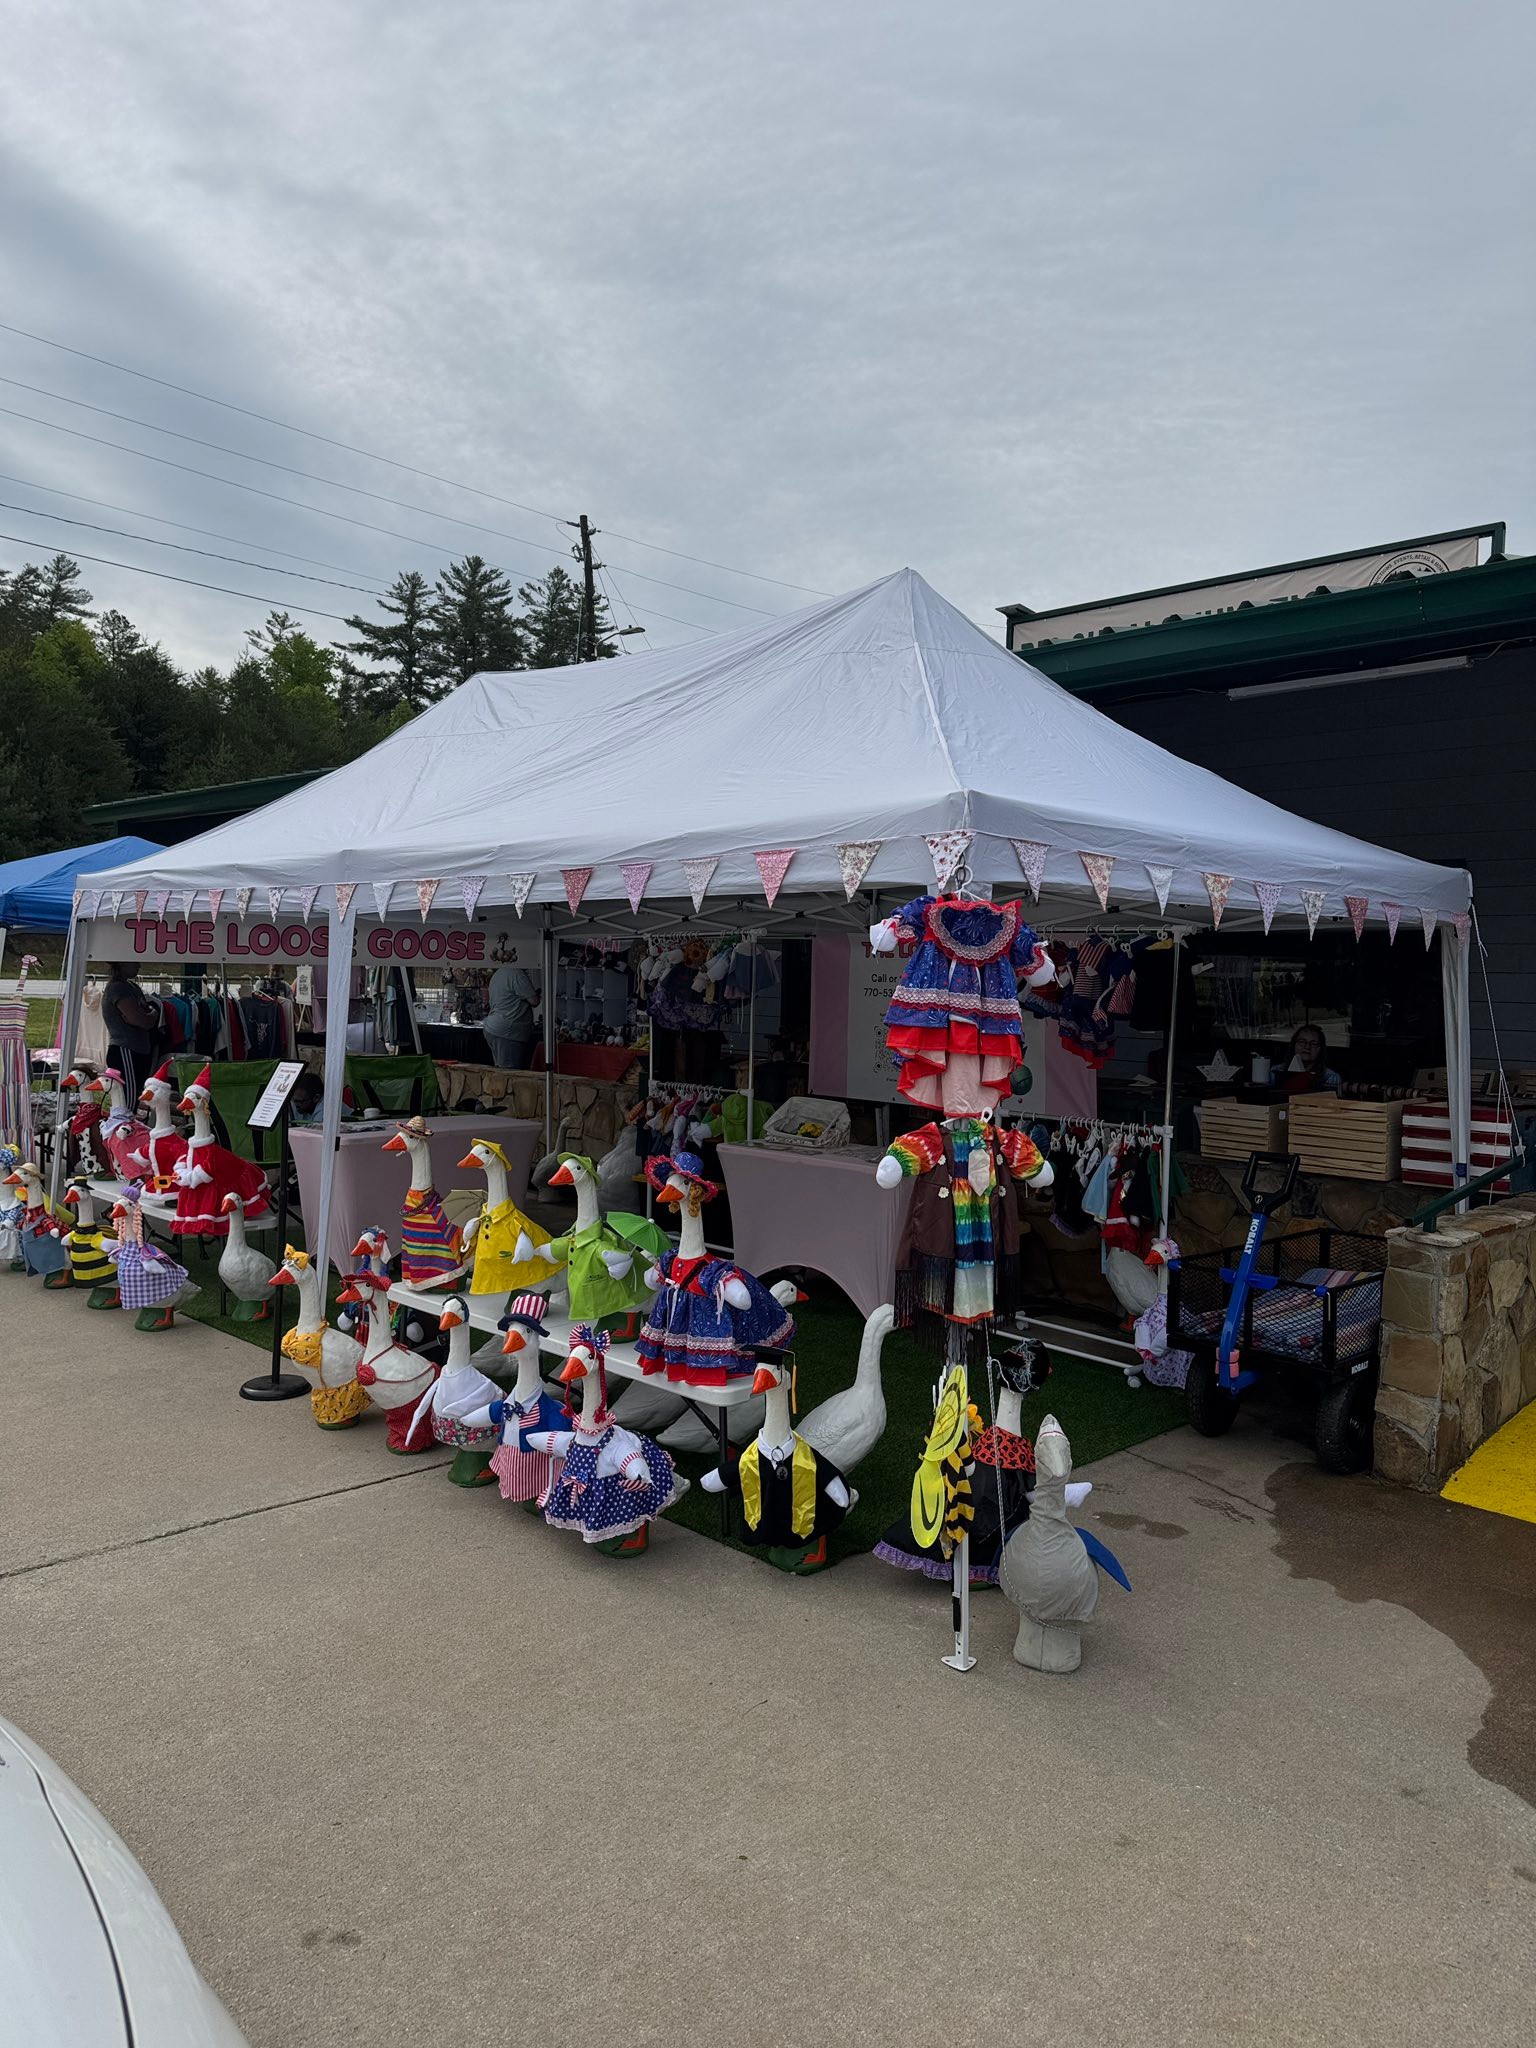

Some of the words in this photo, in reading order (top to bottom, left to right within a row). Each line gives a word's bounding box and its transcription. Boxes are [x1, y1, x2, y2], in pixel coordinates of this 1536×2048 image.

[124, 918, 215, 955] THE
[226, 922, 358, 958] LOOS
[367, 927, 486, 961] GOOSE
[871, 973, 887, 983] Call
[863, 987, 896, 998] 770-53
[1243, 1218, 1260, 1255] KOBALT
